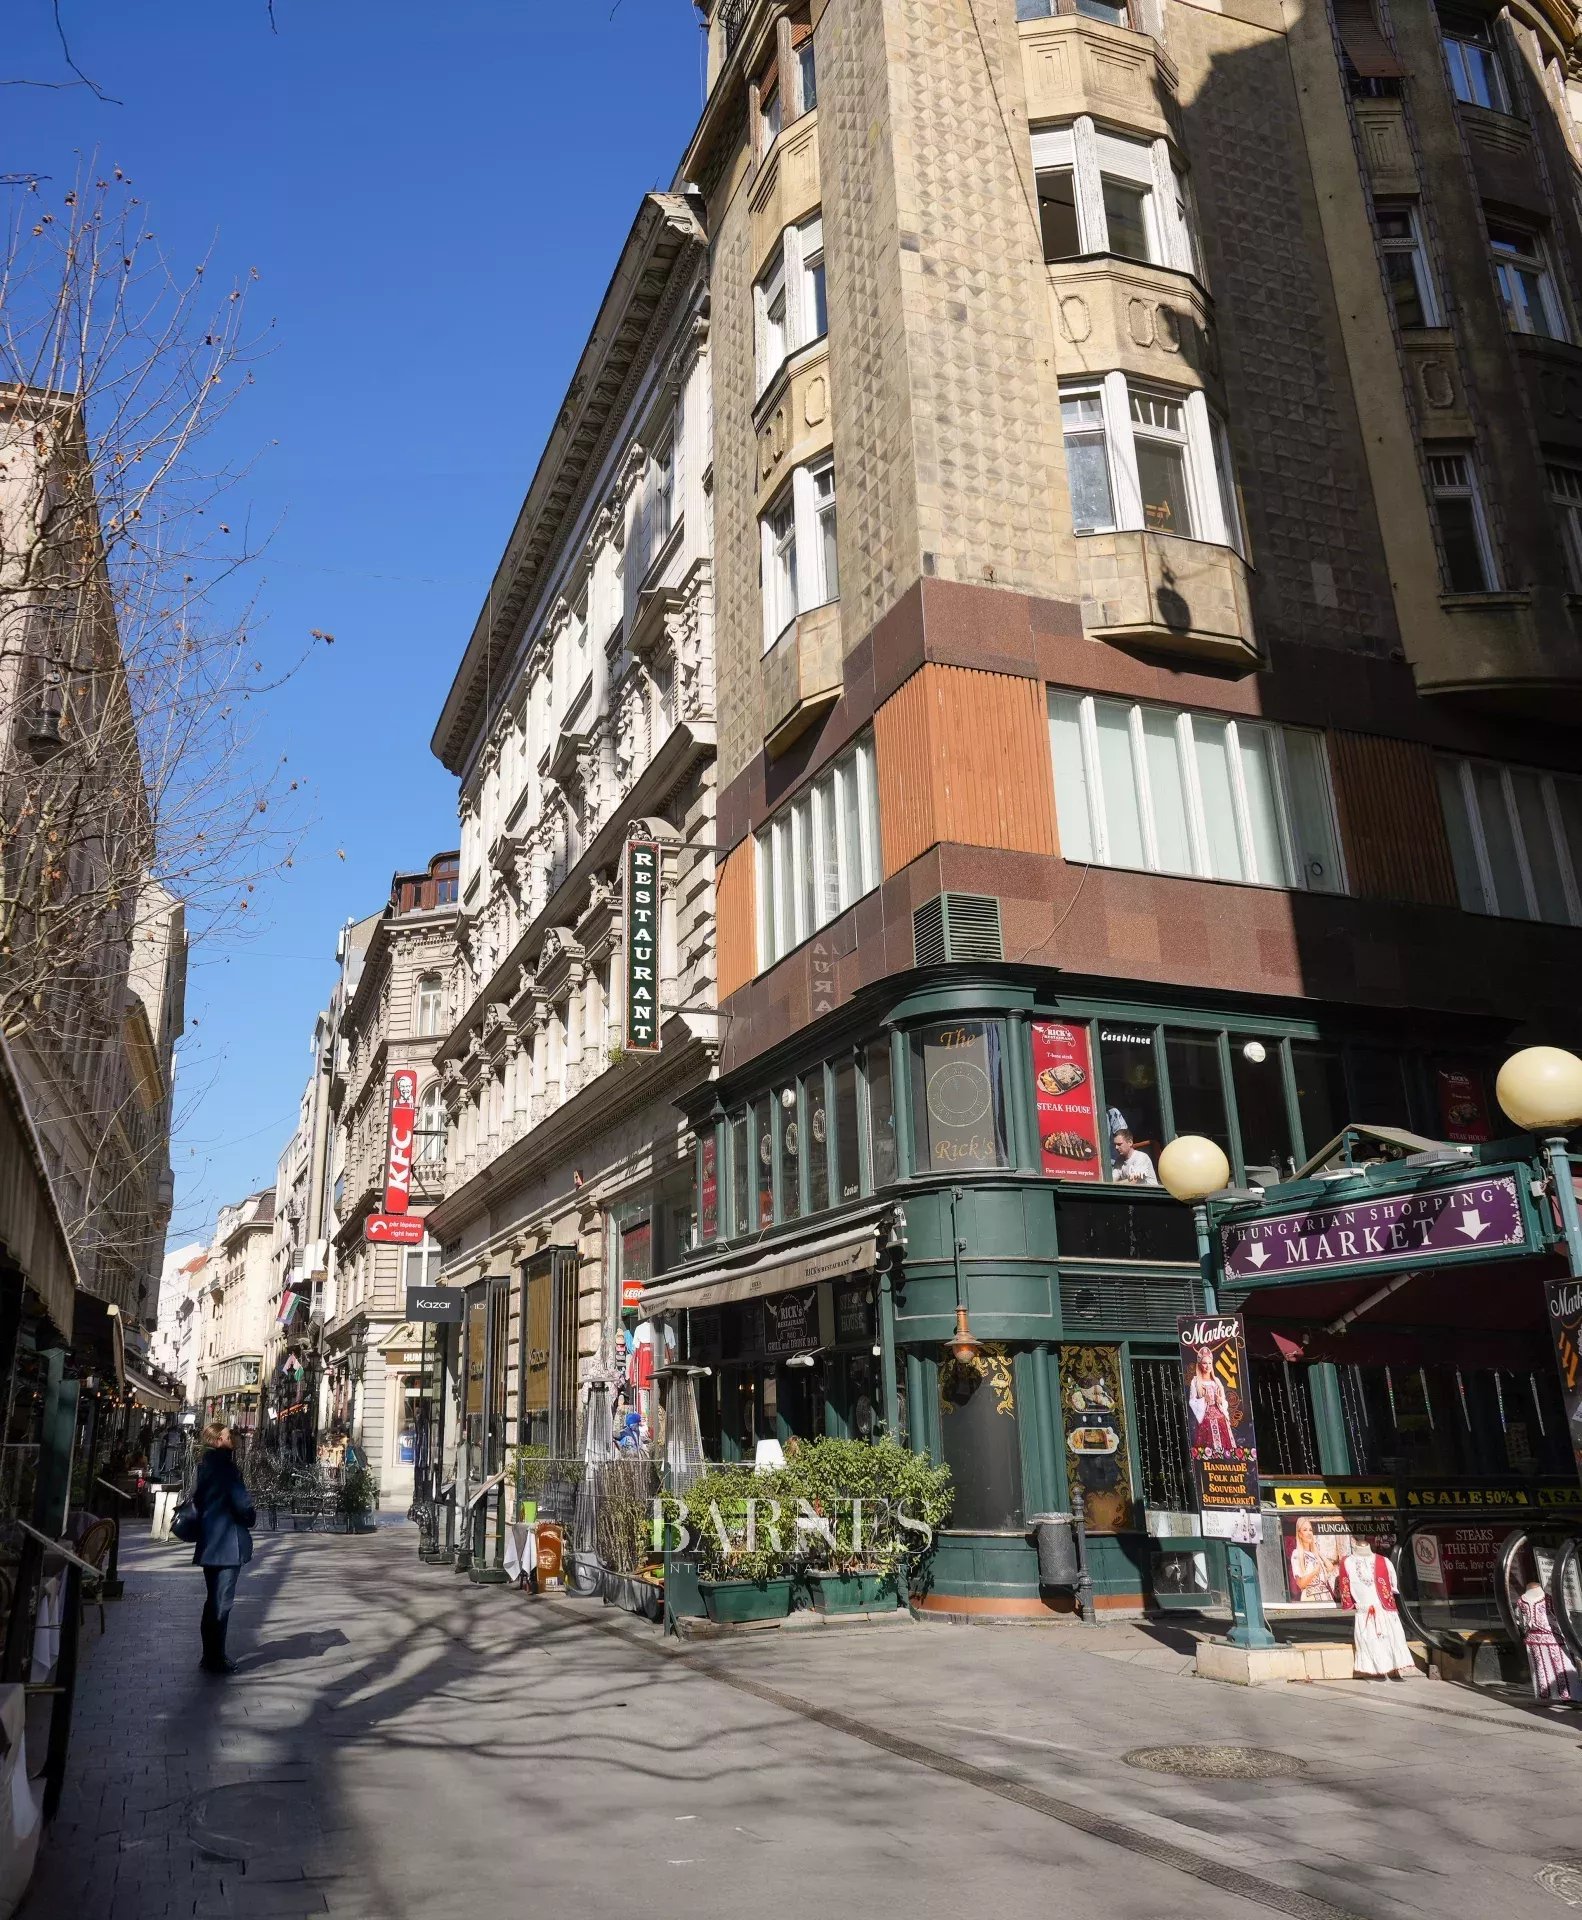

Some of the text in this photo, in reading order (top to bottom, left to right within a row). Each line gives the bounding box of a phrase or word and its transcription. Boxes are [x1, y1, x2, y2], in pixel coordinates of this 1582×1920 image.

[633, 852, 653, 1039] RESTAURANT
[940, 1027, 977, 1050] The
[1101, 1031, 1151, 1045] Casablanca
[1037, 1102, 1091, 1115] STEAK HOUSE
[935, 1135, 994, 1162] Rick's
[388, 1124, 412, 1193] KFC
[1236, 1189, 1494, 1241] HUNGARIAN SHOPPING
[391, 1230, 405, 1238] right
[1284, 1217, 1436, 1265] MARKET
[624, 1288, 644, 1298] LEGO
[416, 1299, 451, 1309] Kazar
[780, 1304, 803, 1319] RICK's
[777, 1318, 806, 1329] RESTAURANT
[1181, 1320, 1239, 1346] Market
[1299, 1491, 1374, 1505] SALE
[1422, 1490, 1514, 1504] SALE 50%
[1317, 1523, 1390, 1533] HUNGARY FOLK ART
[1455, 1529, 1494, 1541] STEAKS
[1447, 1543, 1467, 1555] THE
[1469, 1543, 1489, 1554] HOT
[1443, 1560, 1454, 1570] No
[1470, 1560, 1485, 1570] low
